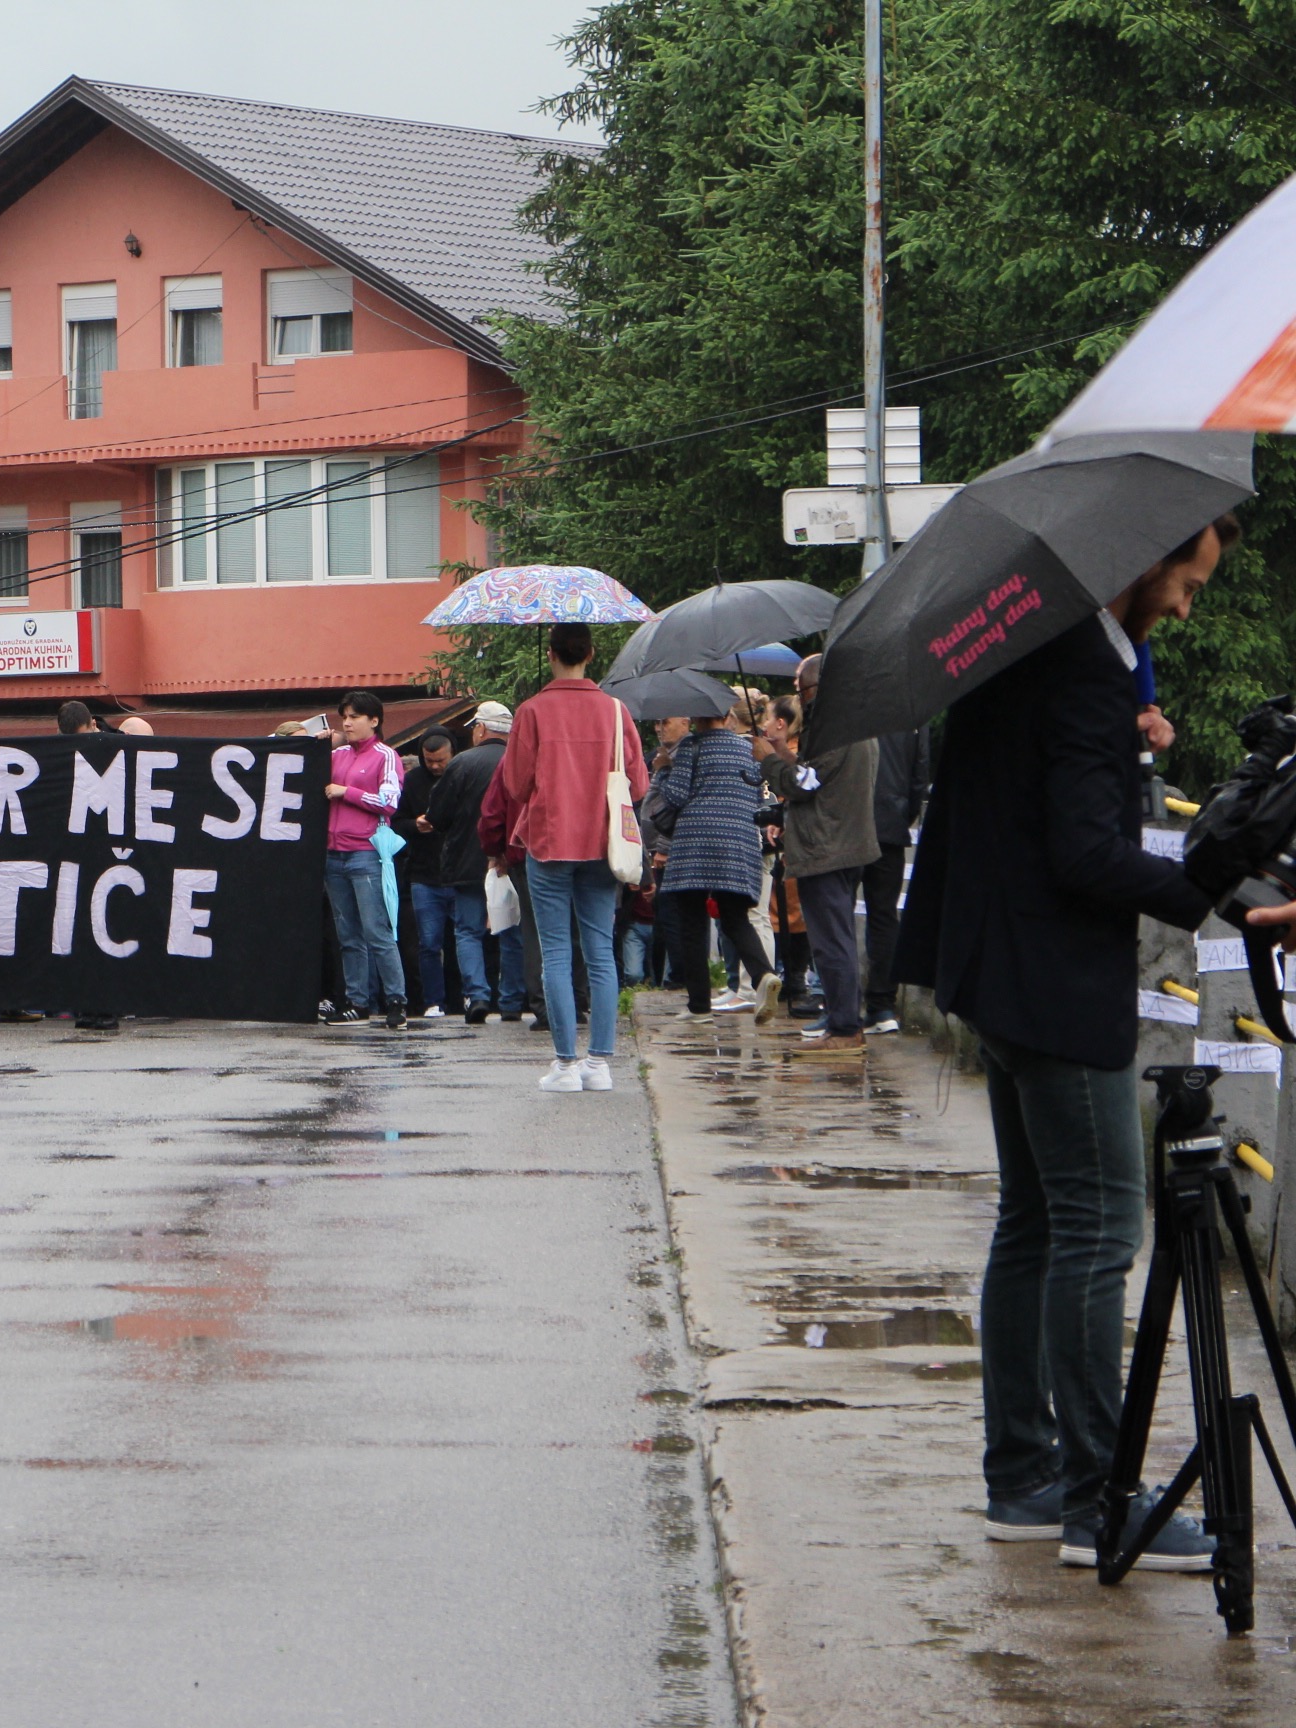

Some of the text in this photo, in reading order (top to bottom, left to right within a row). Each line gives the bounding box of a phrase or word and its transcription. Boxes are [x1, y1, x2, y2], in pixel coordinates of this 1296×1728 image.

[34, 645, 73, 655] KUHINJA
[929, 605, 987, 658] Rainy
[945, 588, 1042, 679] Funny day
[68, 750, 178, 843] ME
[201, 744, 304, 841] SE
